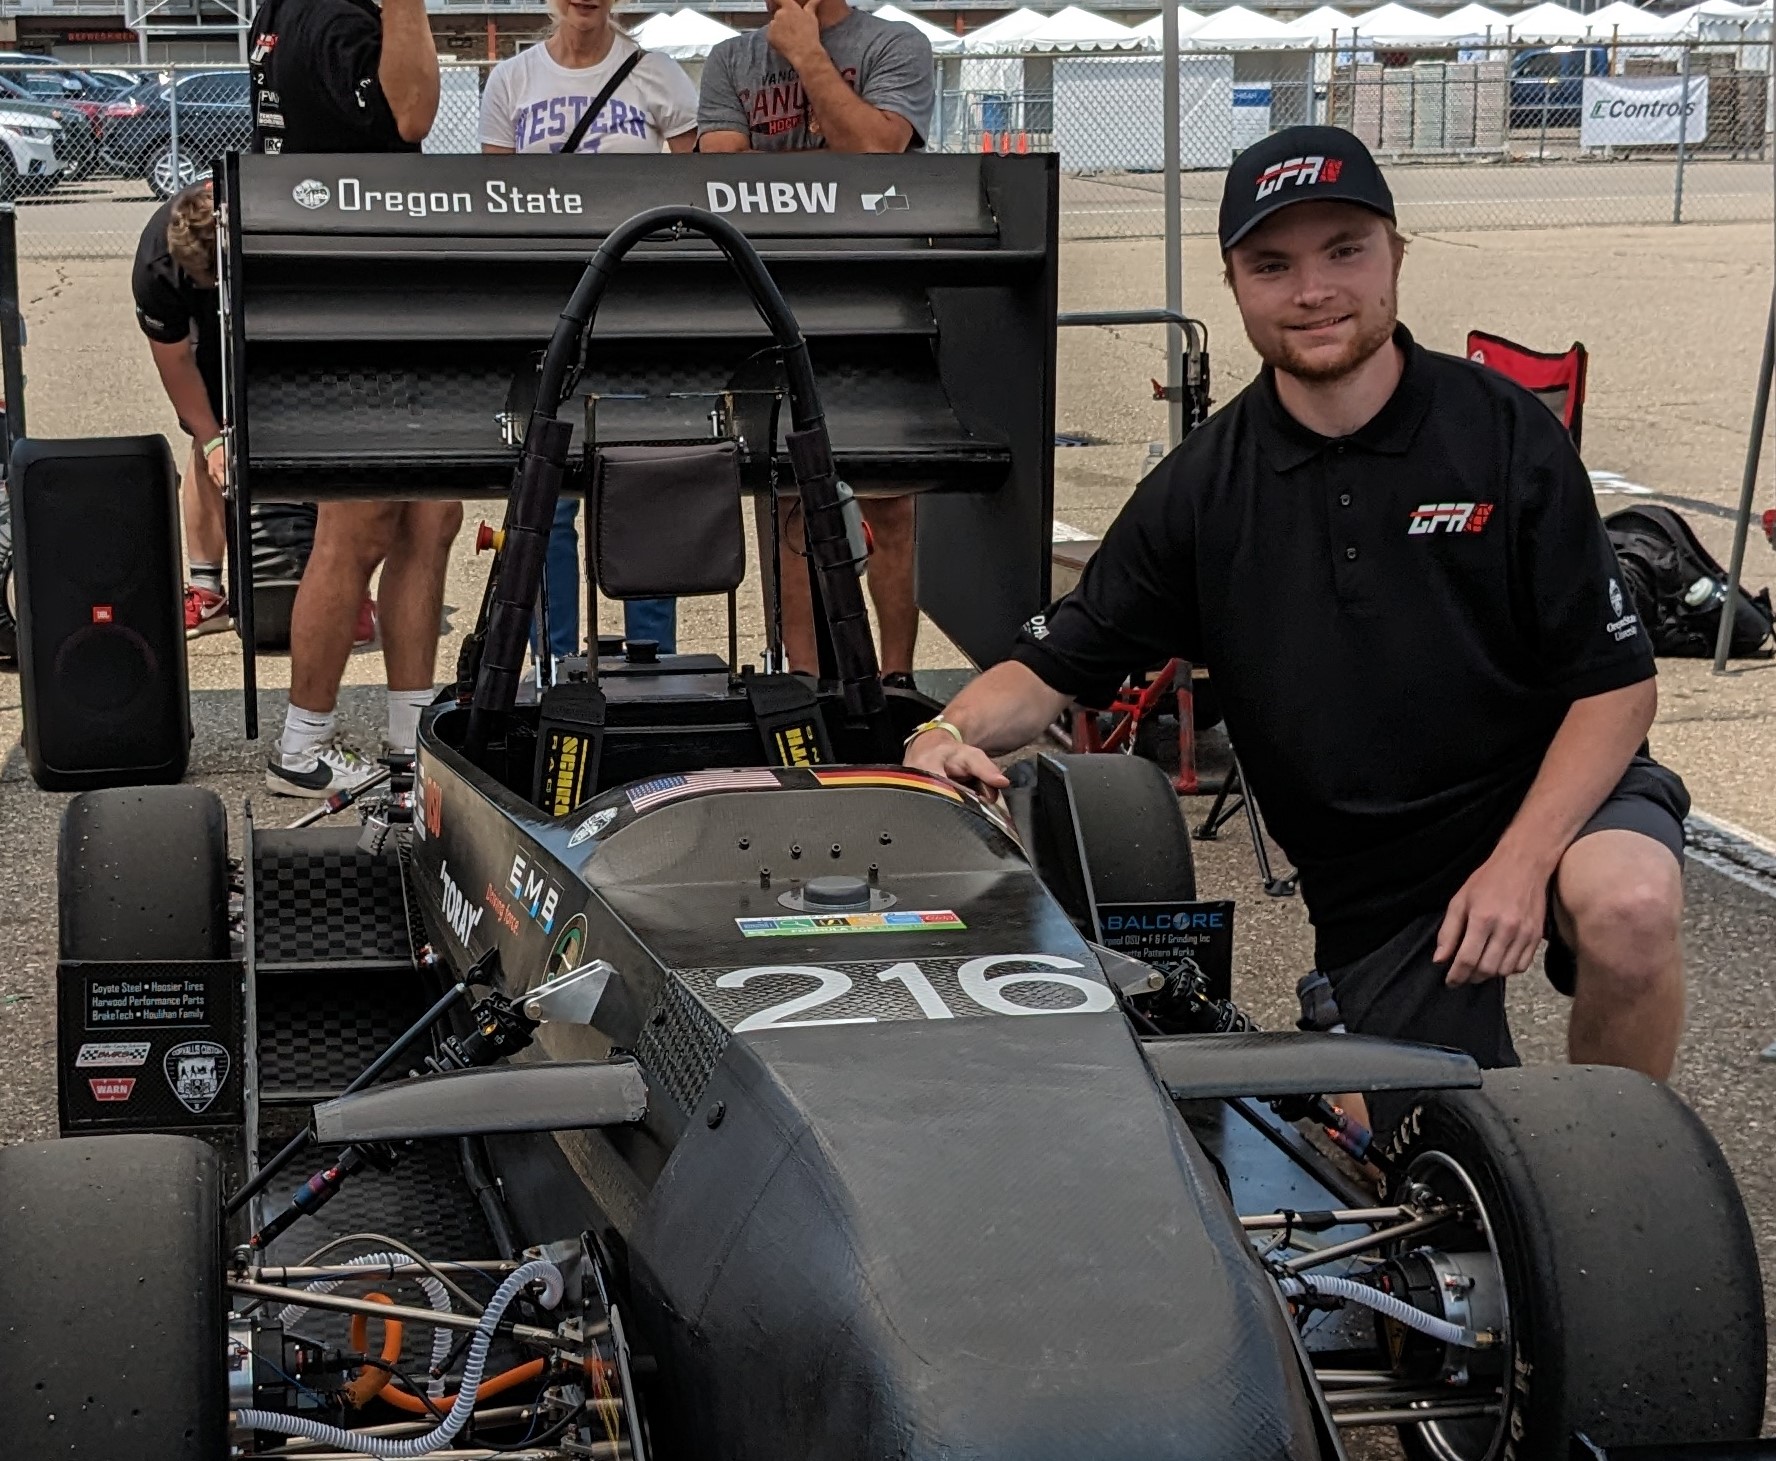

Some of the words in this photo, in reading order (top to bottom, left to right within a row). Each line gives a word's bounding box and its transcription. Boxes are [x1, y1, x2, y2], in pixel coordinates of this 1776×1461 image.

[338, 178, 472, 217] Oregon
[486, 180, 583, 214] State
[706, 181, 837, 214] DHBW
[92, 982, 120, 995] Coyote
[121, 981, 142, 993] Steel
[151, 981, 182, 992] Hoosier
[184, 980, 204, 991] Tires
[716, 954, 1117, 1034] 216
[92, 996, 127, 1007] Harwood
[128, 995, 180, 1006] Performance
[182, 994, 205, 1005] Parts
[179, 1008, 204, 1019] Family
[97, 1085, 128, 1094] WARN
